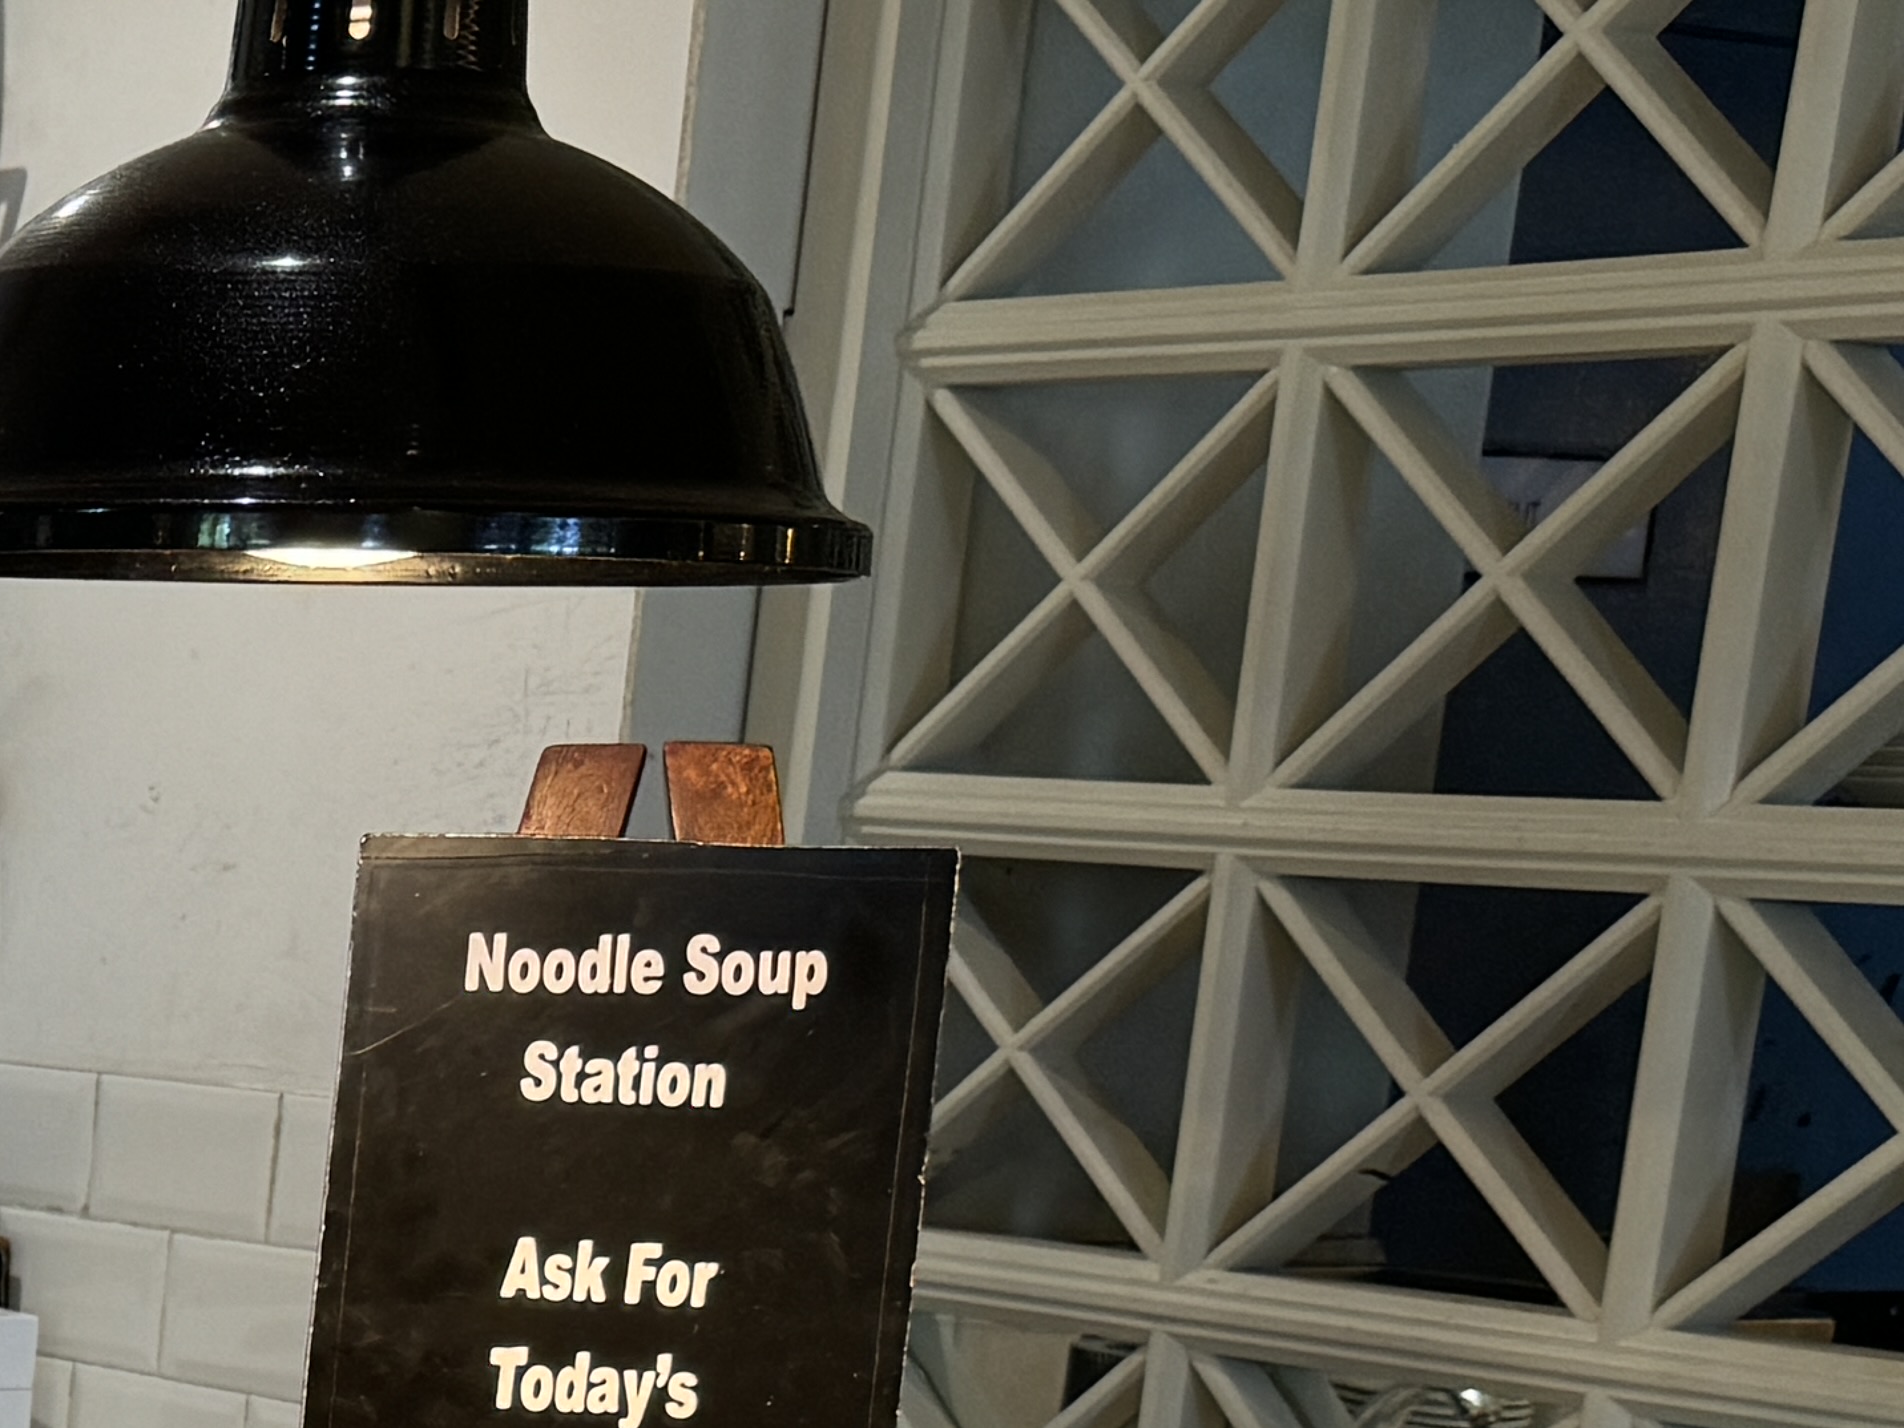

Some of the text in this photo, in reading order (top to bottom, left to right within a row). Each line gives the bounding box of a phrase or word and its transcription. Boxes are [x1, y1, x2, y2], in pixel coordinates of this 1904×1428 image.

[463, 931, 829, 1011] Noodle Soup
[519, 1040, 728, 1109] Station
[499, 1236, 720, 1308] Ask For
